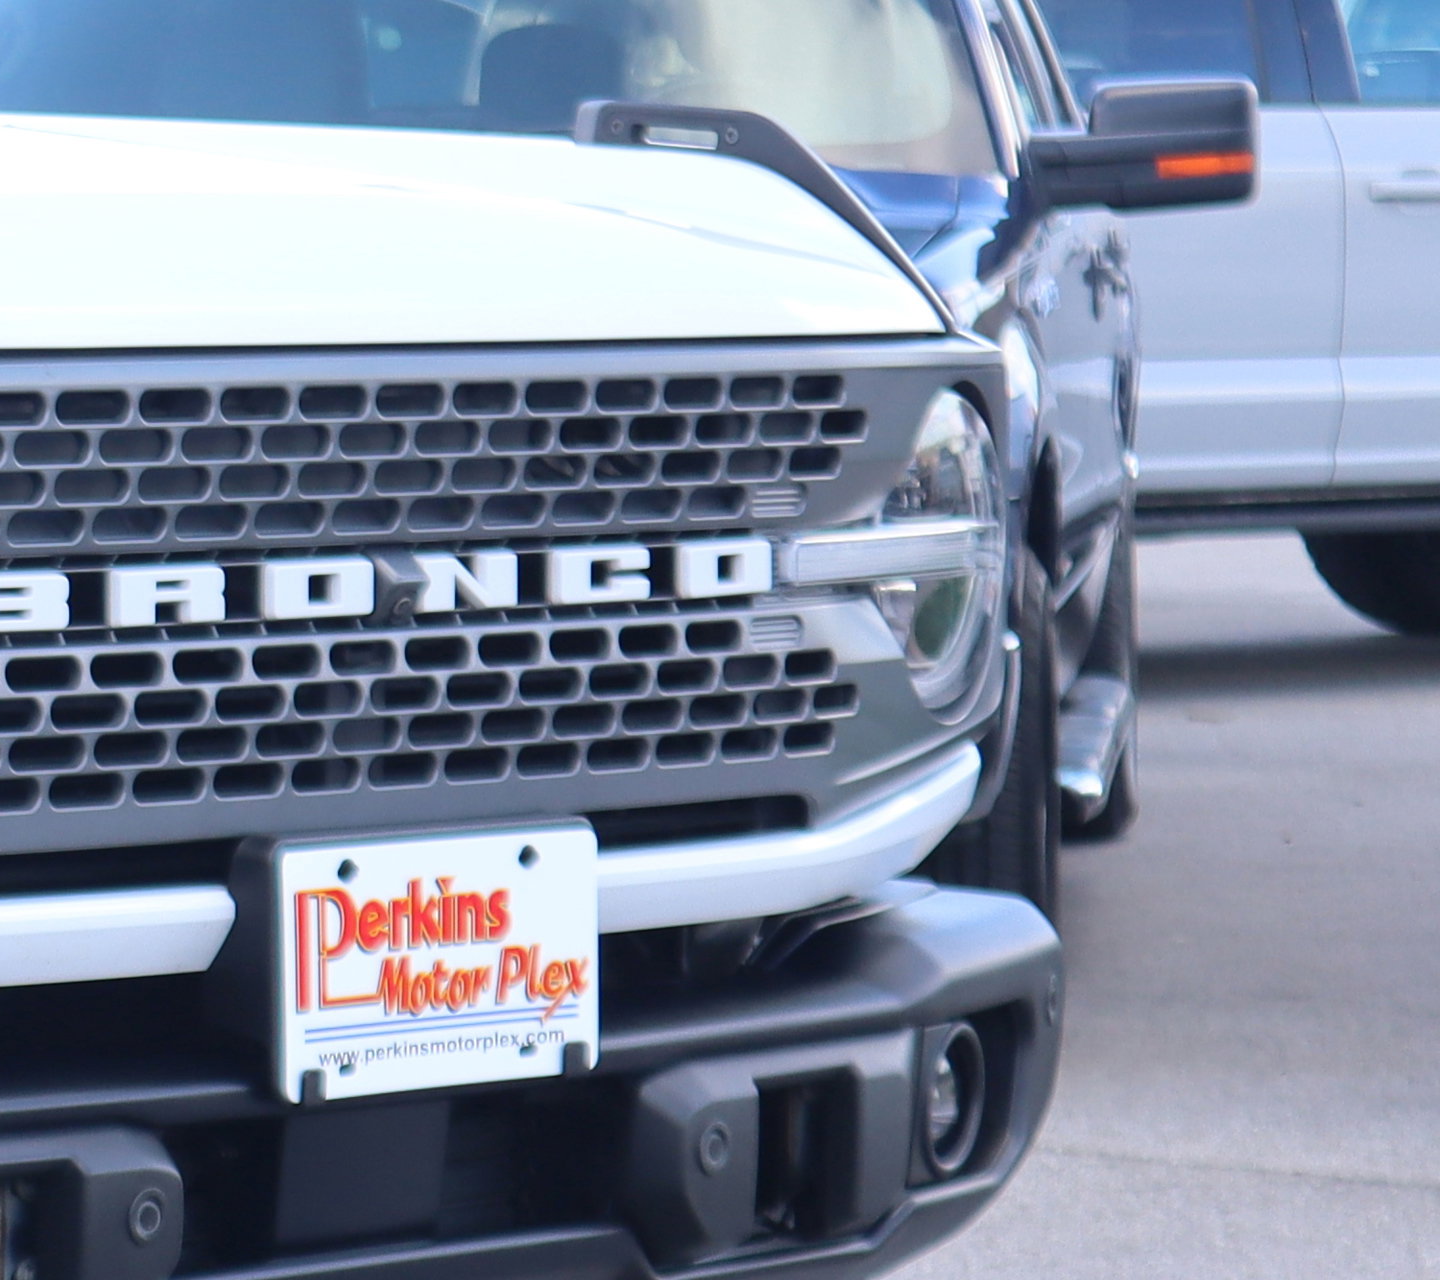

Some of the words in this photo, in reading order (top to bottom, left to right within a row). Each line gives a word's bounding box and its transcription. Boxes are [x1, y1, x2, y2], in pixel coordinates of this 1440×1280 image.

[294, 876, 513, 1013] Perkins
[378, 956, 493, 1016] Motor
[496, 943, 589, 1027] Plex
[319, 1029, 565, 1066] www.perkinsmotorplex.com
